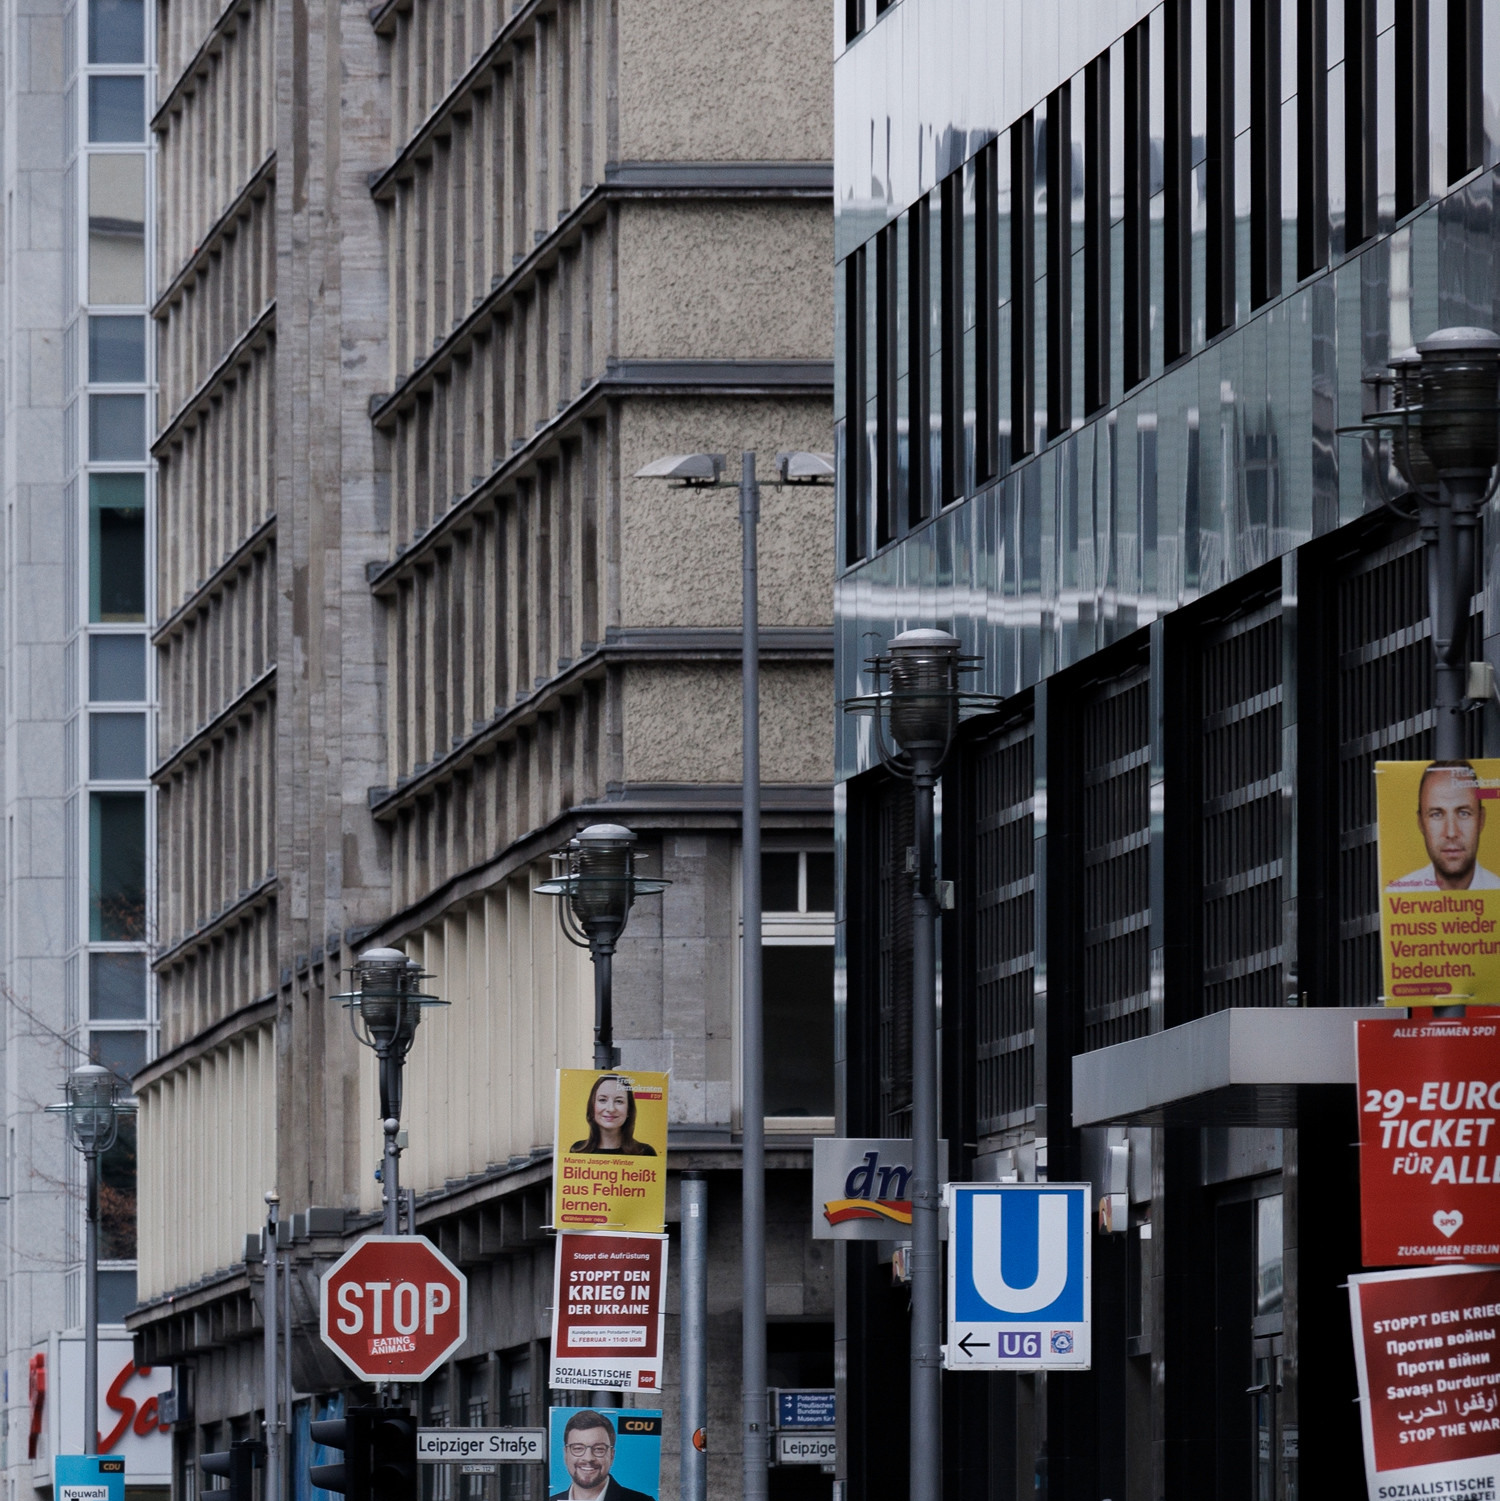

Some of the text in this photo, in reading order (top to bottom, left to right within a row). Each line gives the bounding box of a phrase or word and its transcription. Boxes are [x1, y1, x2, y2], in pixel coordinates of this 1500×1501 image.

[1389, 896, 1484, 916] Verwaltung
[1390, 917, 1496, 937] muss wieder
[1391, 960, 1476, 980] bedeuten.
[1393, 1025, 1496, 1038] ALLE STIMMEN SPD!
[1379, 1118, 1496, 1148] TICKET
[588, 1159, 634, 1167] Jasper-Winter
[1392, 1152, 1434, 1176] FÜR
[564, 1166, 656, 1183] Bildung heißt
[563, 1183, 645, 1198] aus Fehlern
[562, 1198, 611, 1212] lernen.
[1440, 1218, 1457, 1227] SPD
[574, 1252, 649, 1261] Stoppt die Aufrüstung
[972, 1194, 1068, 1314] U
[1398, 1244, 1500, 1257] ZUSAMMEN BERLIN
[570, 1271, 649, 1282] STOPPT DEN
[569, 1286, 649, 1301] KRIEG IN
[337, 1282, 450, 1335] STOP
[568, 1304, 649, 1315] DER UKRAINE
[1373, 1313, 1428, 1334] STOPPT
[1431, 1308, 1460, 1326] DEN
[371, 1344, 417, 1355] ANIMALS
[373, 1336, 410, 1347] EATING
[1003, 1335, 1038, 1356] U6
[1386, 1328, 1496, 1356] Против войны
[555, 1367, 632, 1379] SOZIALISTISCHE
[1397, 1352, 1490, 1378] Проти війни
[555, 1377, 632, 1387] GLEICHHEITSPARTEI
[1387, 1383, 1434, 1400] Savaşı
[797, 1402, 833, 1410] Preußisches
[1398, 1389, 1499, 1425] أوقفوا الحرب
[625, 1421, 655, 1432] CDU
[1399, 1416, 1500, 1444] STOP THE WAR
[419, 1435, 537, 1456] Leipziger Straße
[783, 1440, 836, 1457] Leipzige
[103, 1463, 121, 1472] CDU
[64, 1490, 106, 1499] Neuwahl
[1379, 1476, 1496, 1500] SOZIALISTISCHE
